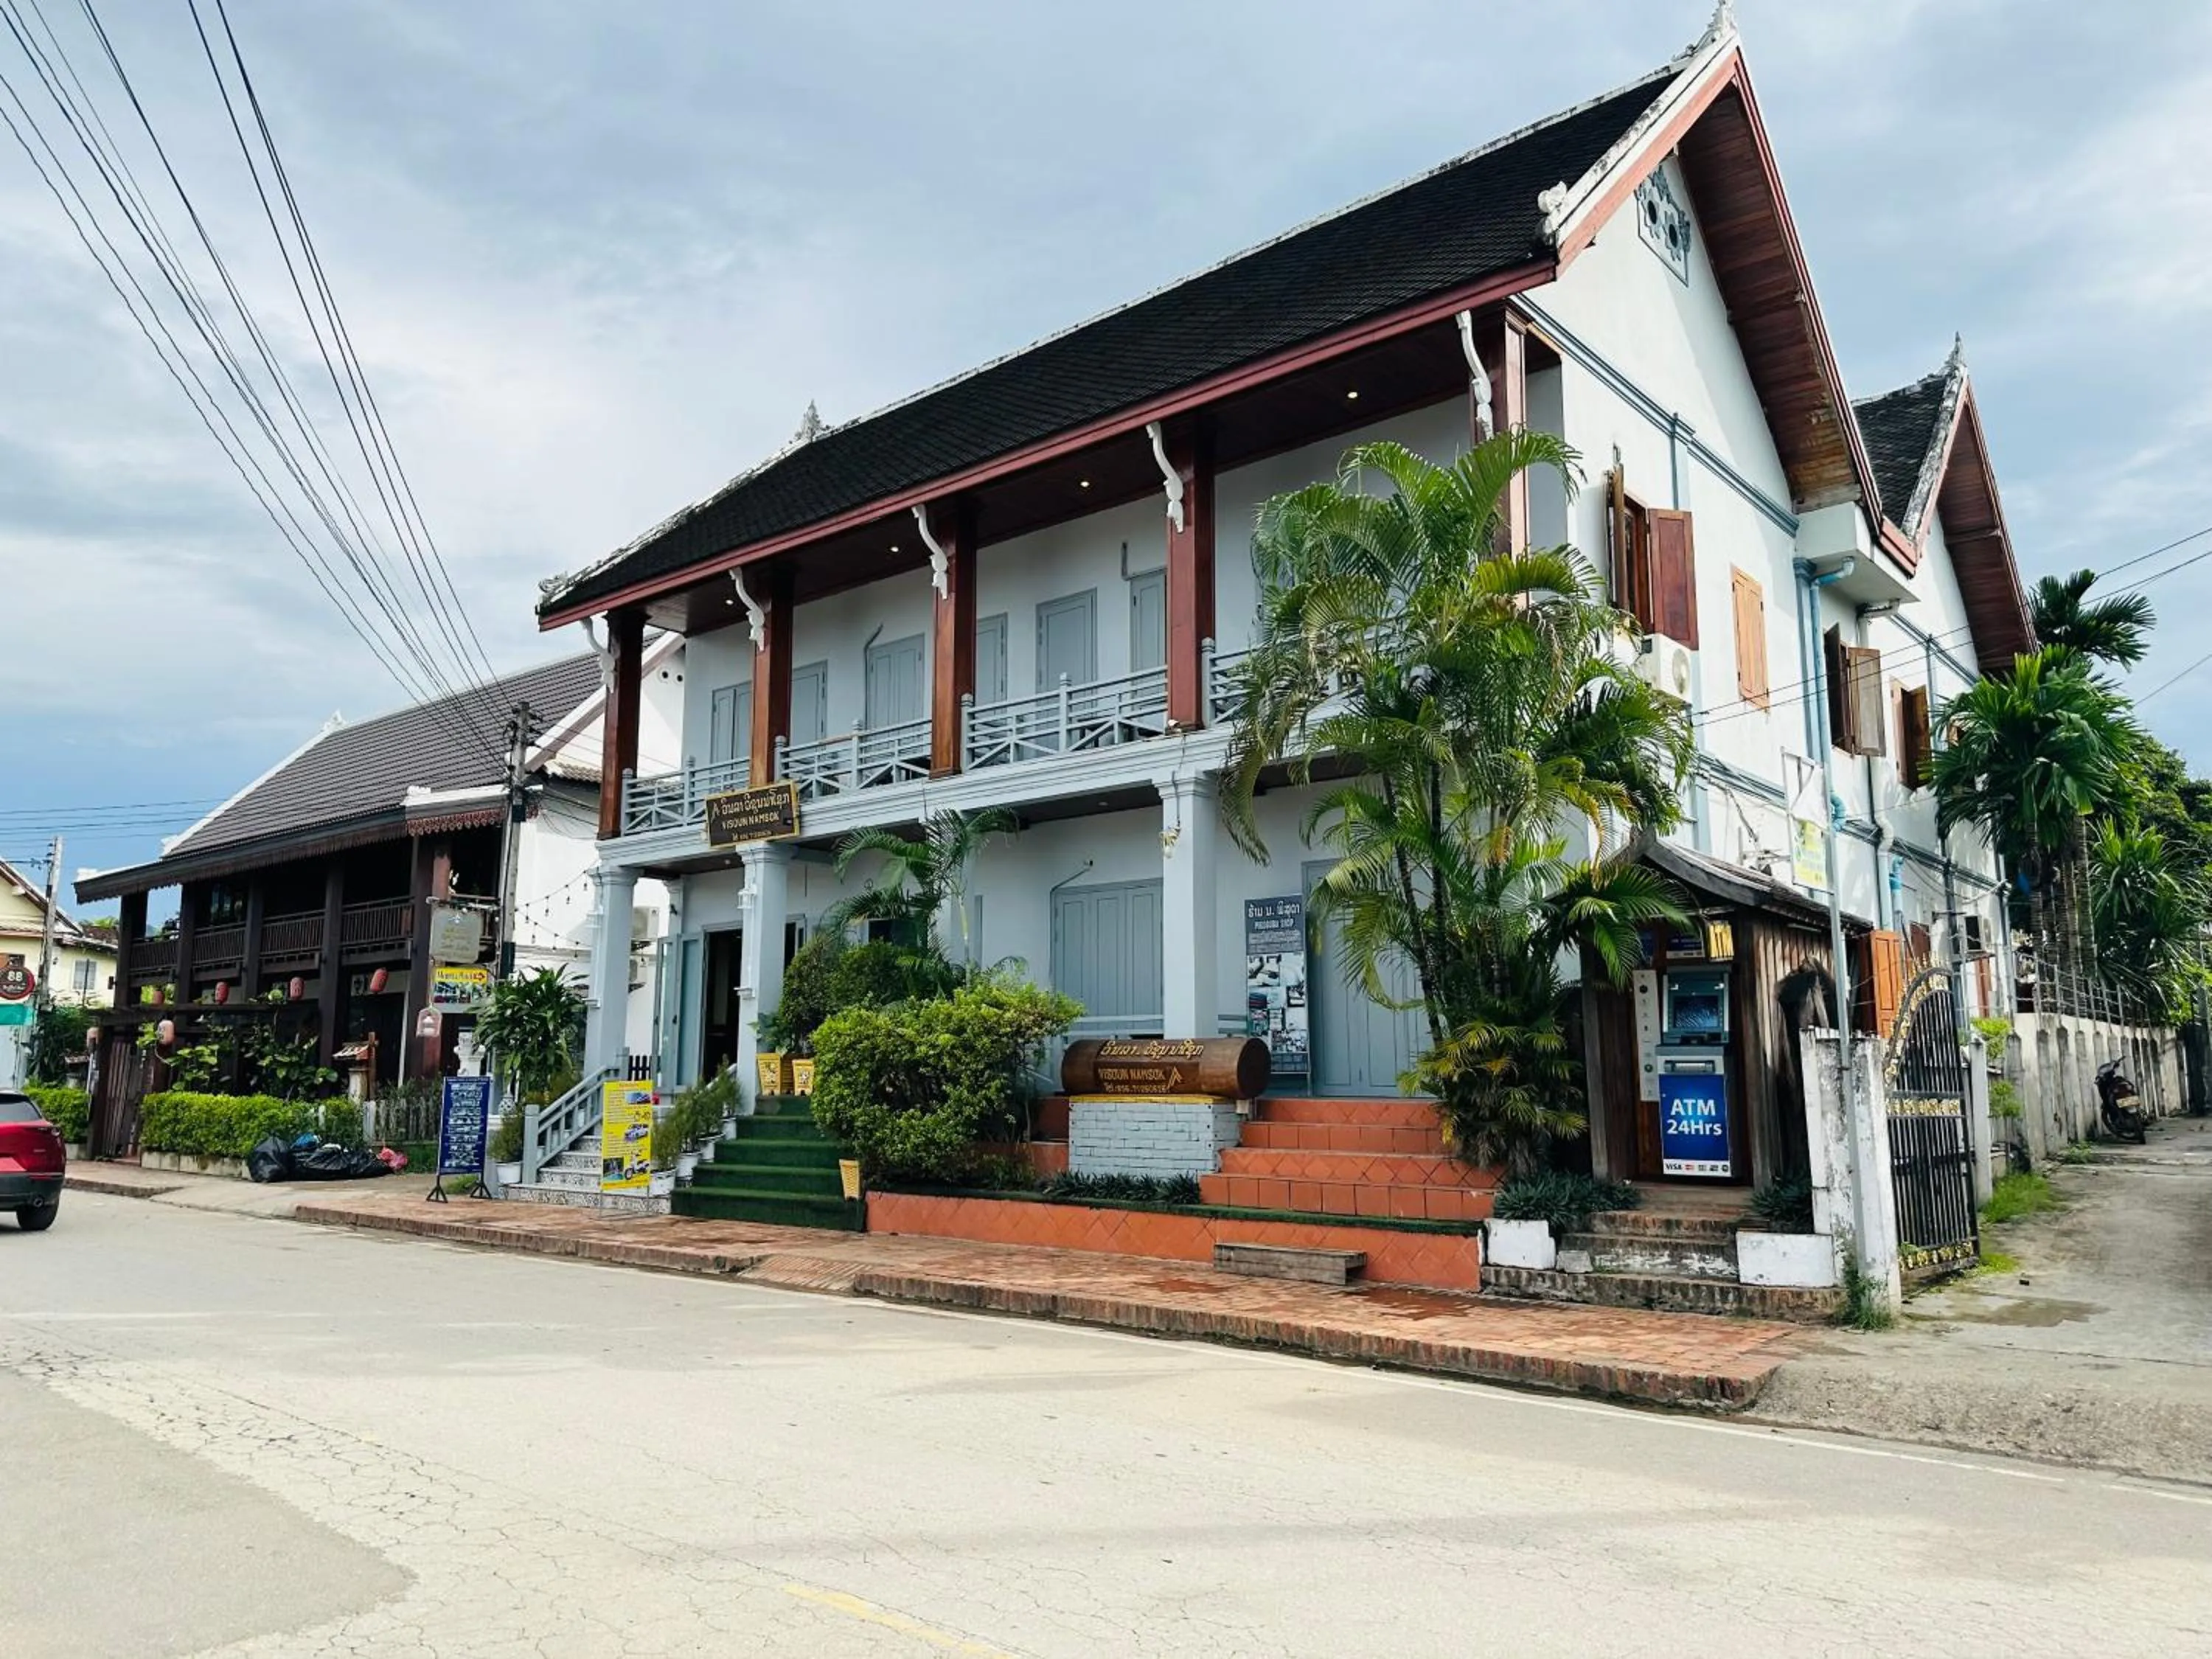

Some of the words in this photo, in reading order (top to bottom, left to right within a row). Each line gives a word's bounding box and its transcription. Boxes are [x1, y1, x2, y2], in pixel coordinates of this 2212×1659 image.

[722, 816, 748, 830] VISOUN
[748, 811, 779, 825] NAMSOK
[1710, 922, 1734, 958] ATM
[7, 970, 23, 982] 88
[1130, 1068, 1166, 1080] NAMSOK
[1670, 1098, 1717, 1116] ATM
[1666, 1119, 1722, 1135] 24Hrs
